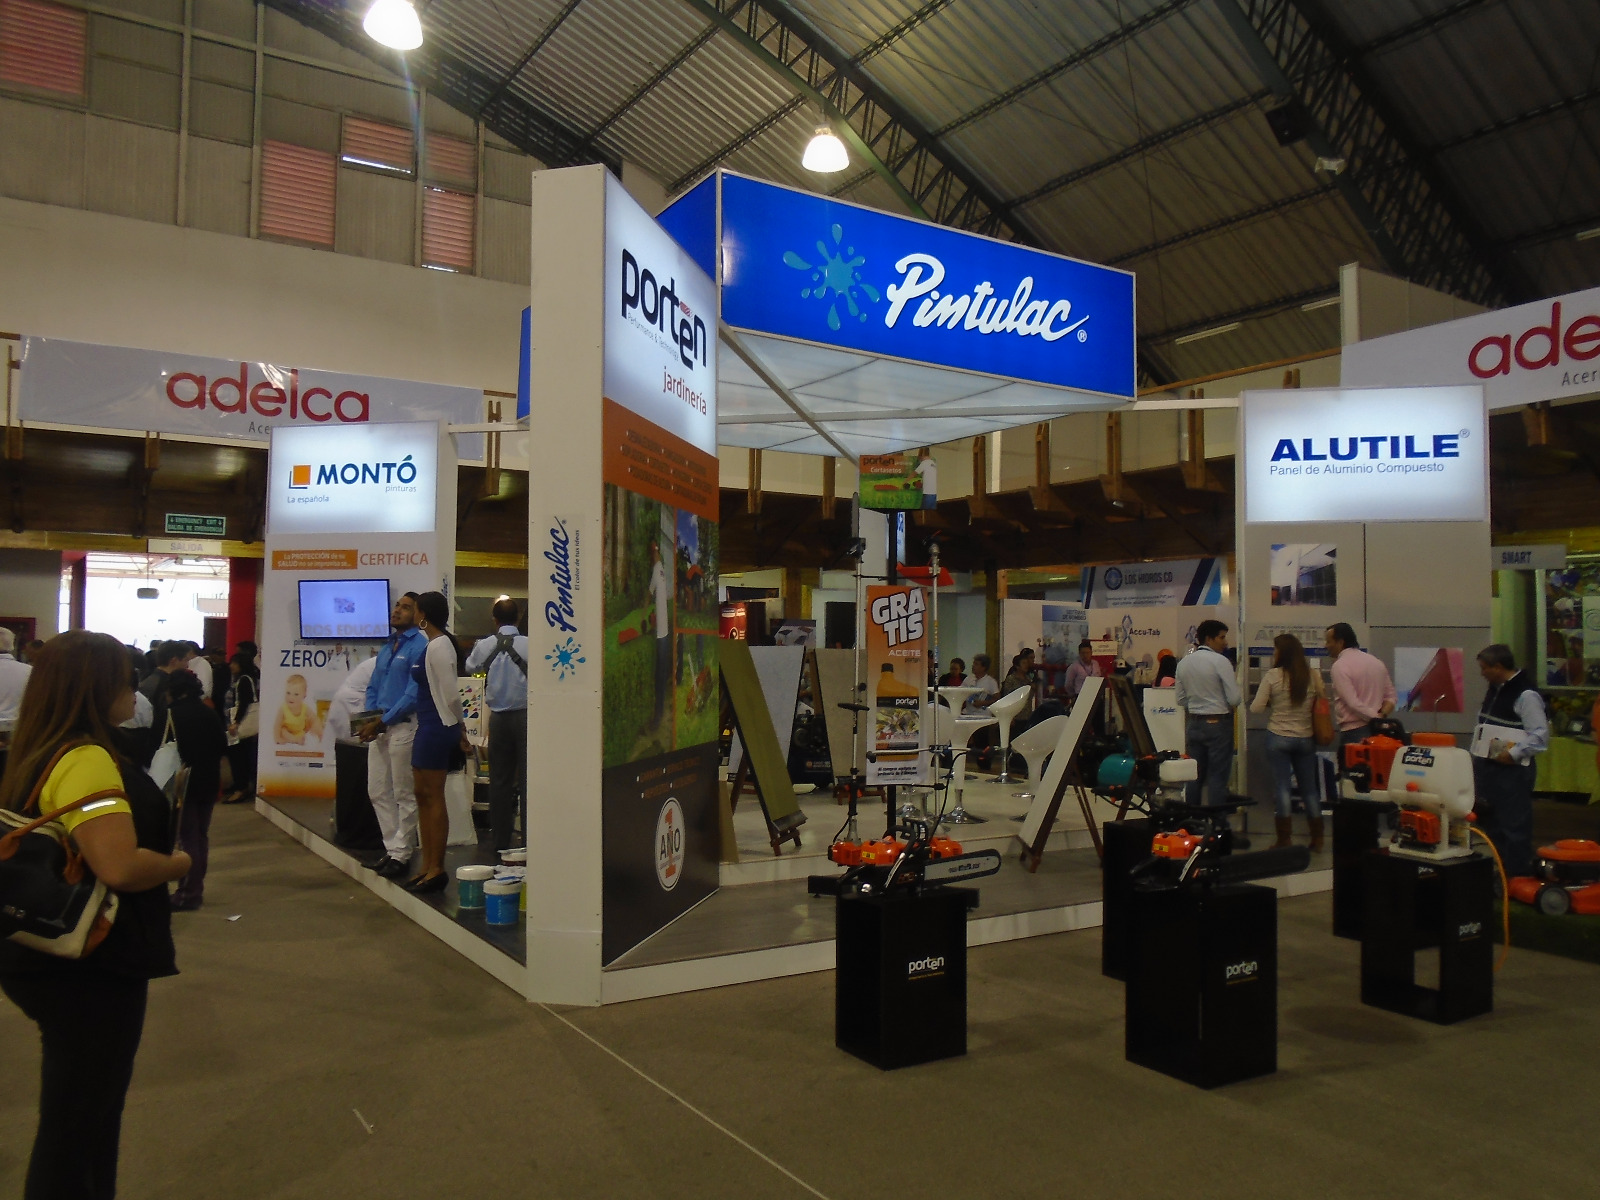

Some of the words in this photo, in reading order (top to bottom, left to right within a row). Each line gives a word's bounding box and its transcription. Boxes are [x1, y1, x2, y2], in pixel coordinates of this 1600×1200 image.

[885, 253, 1090, 341] Pintulac
[621, 248, 707, 371] porten
[166, 362, 370, 422] adelca
[662, 365, 707, 416] jardinería
[1270, 434, 1460, 461] ALUTILE
[316, 454, 417, 485] MONTÓ
[863, 456, 895, 466] porten
[1270, 465, 1302, 476] Panel
[1305, 465, 1320, 475] de
[1323, 463, 1373, 474] Aluminio
[1376, 462, 1445, 475] Compuesto
[385, 485, 417, 493] pinturas
[297, 495, 330, 504] española
[170, 542, 204, 551] SALIDA
[291, 552, 330, 560] PROTECCIÓN
[360, 553, 429, 566] CERTIFICA
[575, 559, 580, 567] de
[544, 516, 577, 632] Pintulac
[871, 587, 926, 625] GRA
[883, 612, 924, 647] TIS
[1129, 627, 1161, 636] Accu-Tab
[280, 650, 327, 667] ZERO
[888, 649, 921, 657] ACEITE
[660, 826, 680, 860] AÑO
[908, 956, 944, 974] porten
[1226, 961, 1258, 979] porten
